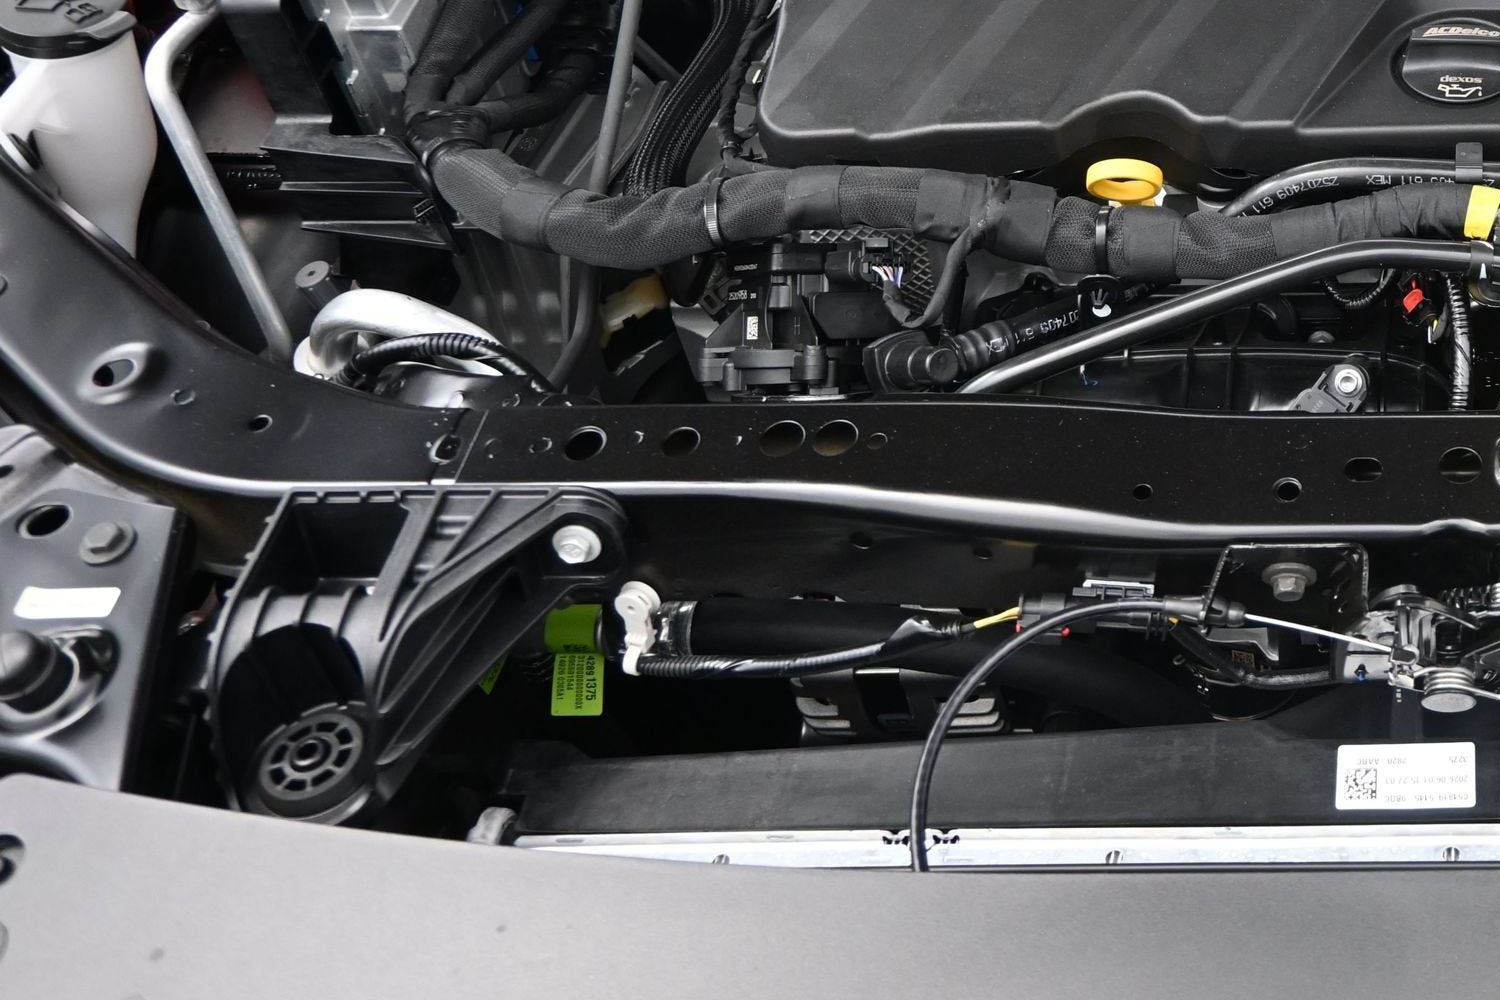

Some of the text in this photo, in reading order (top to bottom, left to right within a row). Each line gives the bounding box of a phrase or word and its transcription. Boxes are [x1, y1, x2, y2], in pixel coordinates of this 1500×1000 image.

[1422, 26, 1500, 38] ACDelco
[1440, 74, 1484, 84] dexos
[1366, 174, 1391, 185] MEX
[1276, 176, 1340, 200] 25207409
[1252, 196, 1274, 214] 611
